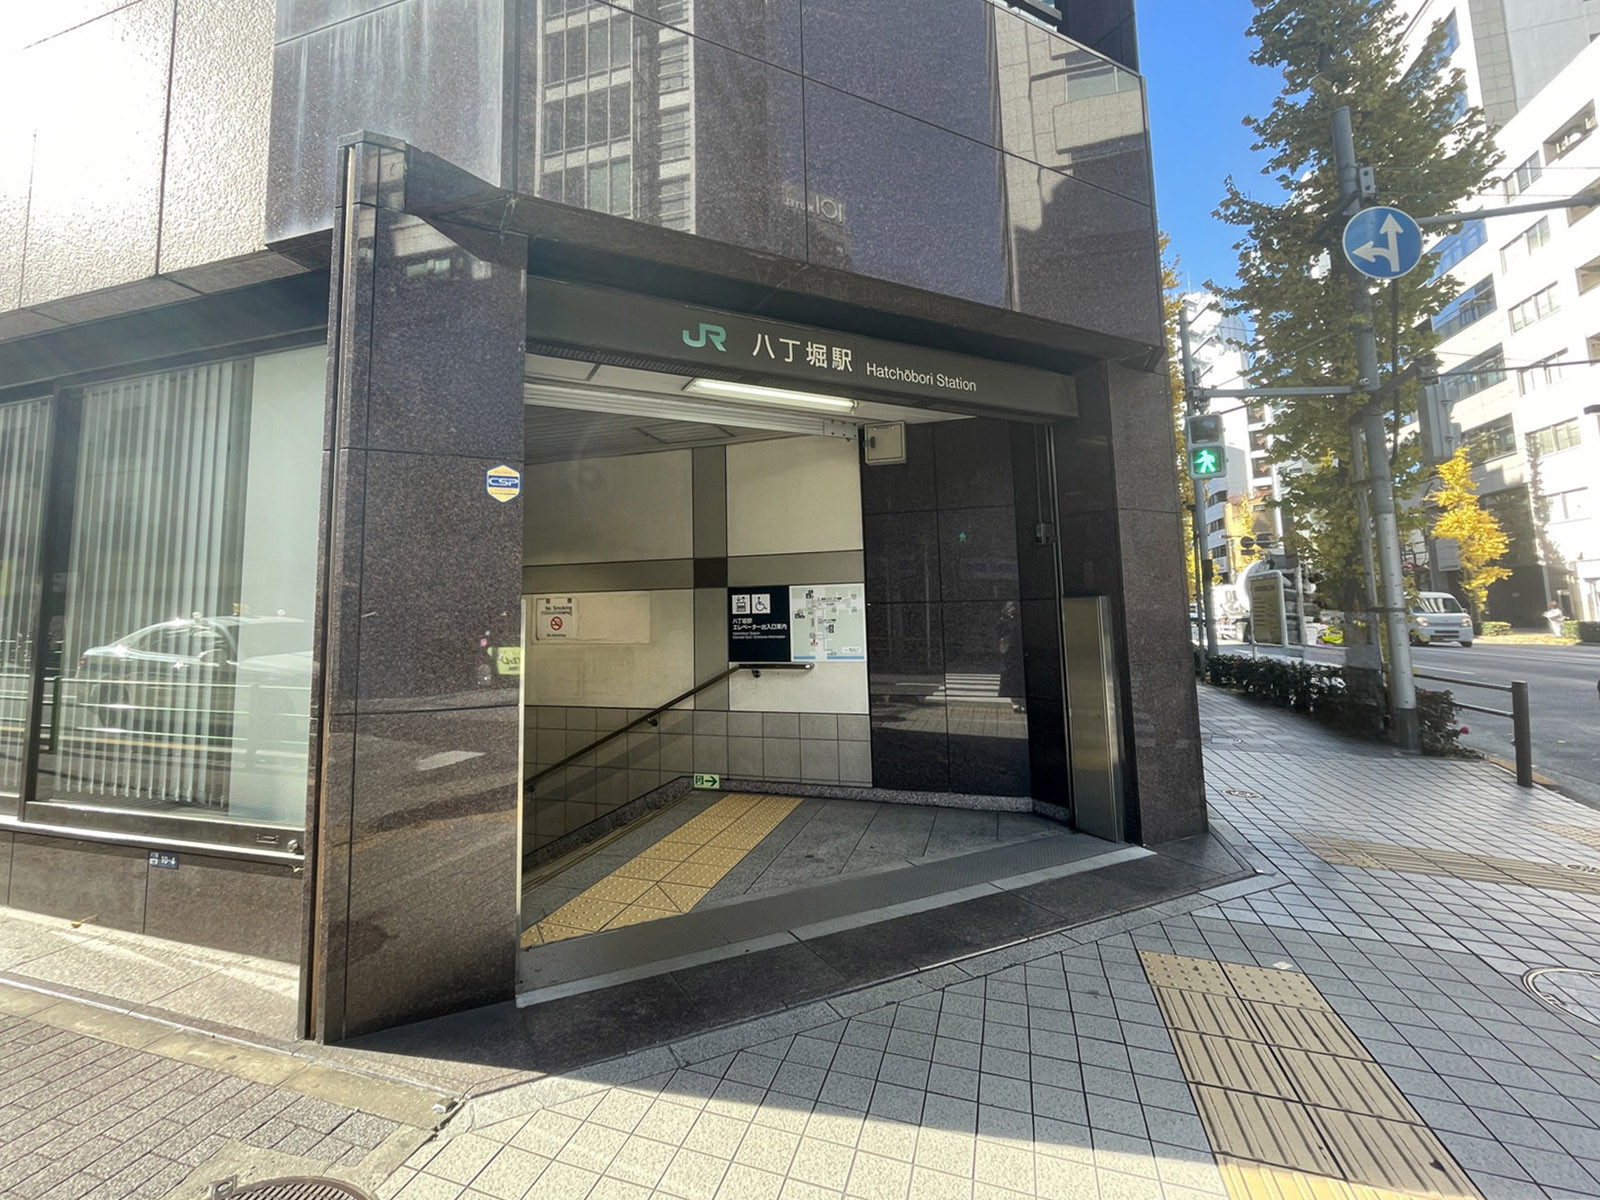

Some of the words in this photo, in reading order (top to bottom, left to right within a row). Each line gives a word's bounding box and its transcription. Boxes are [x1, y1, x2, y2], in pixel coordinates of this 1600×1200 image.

[682, 323, 727, 352] JR
[752, 333, 853, 372] 八丁堀駅
[866, 362, 934, 385] Hatchōbori
[936, 374, 977, 392] Station
[489, 477, 518, 486] CSP
